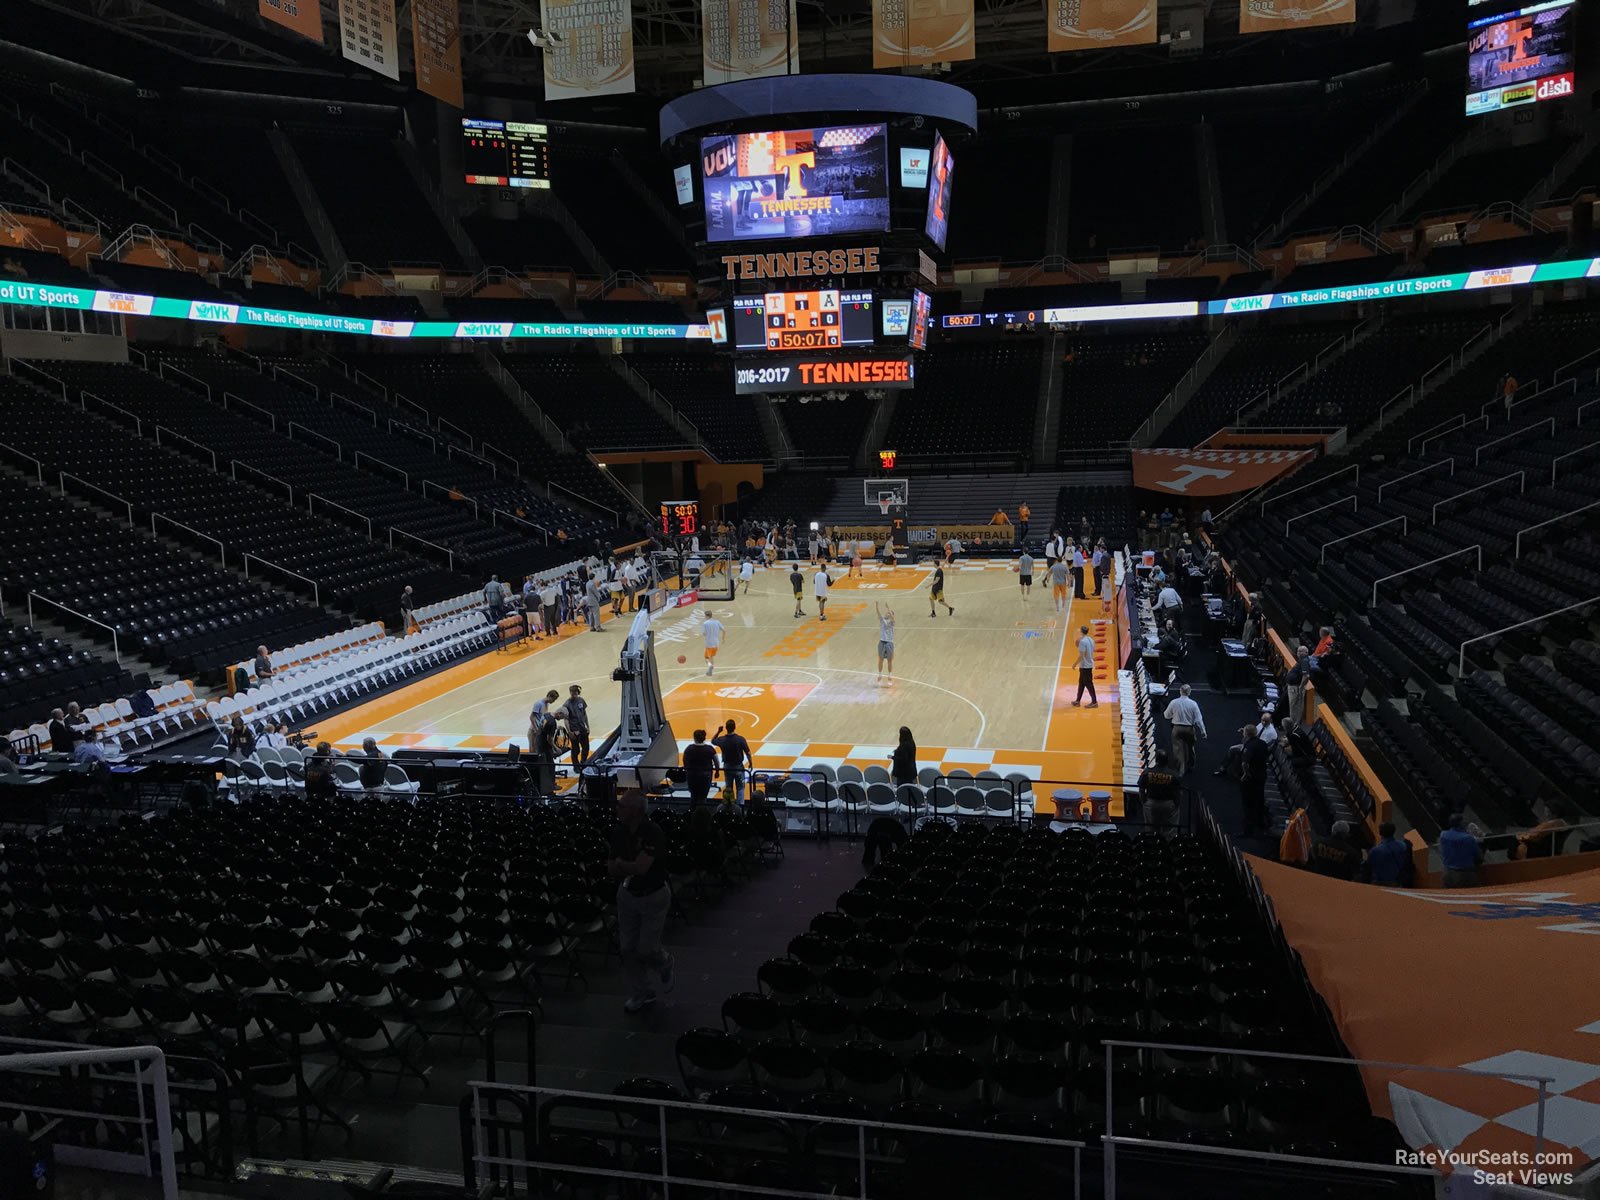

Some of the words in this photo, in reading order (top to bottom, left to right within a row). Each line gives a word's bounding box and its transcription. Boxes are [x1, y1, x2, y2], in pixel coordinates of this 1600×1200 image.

[546, 1, 624, 18] TOURNAMENT
[1058, 0, 1079, 9] 1972
[1249, 2, 1274, 11] 2008
[1058, 9, 1079, 17] 1977
[550, 13, 624, 30] CHAMPIONS
[738, 17, 759, 25] 2001
[1058, 18, 1079, 26] 1982
[738, 26, 759, 34] 2002
[738, 34, 760, 42] 2003
[738, 42, 760, 51] 2004
[1509, 28, 1532, 60] T
[1538, 77, 1571, 98] dish
[326, 105, 342, 115] 325
[1124, 101, 1140, 110] 330
[776, 151, 816, 197] T
[760, 197, 832, 212] TENNESSEE
[721, 246, 880, 280] TENNESSEE
[1, 286, 14, 298] of
[18, 287, 34, 300] UT
[39, 289, 79, 304] Sports
[1281, 293, 1298, 304] The
[1301, 290, 1329, 303] Radio
[1331, 286, 1380, 301] Flagships
[1382, 284, 1395, 295] of
[1397, 281, 1412, 293] UT
[1415, 278, 1452, 294] Sports
[769, 296, 780, 308] T
[824, 294, 834, 307] A
[247, 309, 262, 321] The
[264, 312, 286, 324] Radio
[288, 314, 322, 329] Flagships
[325, 318, 332, 328] of
[333, 319, 342, 329] UT
[344, 320, 365, 332] Sports
[773, 317, 779, 326] 0
[811, 318, 817, 326] 4
[826, 314, 833, 324] 0
[949, 316, 975, 326] 50:07
[1028, 311, 1035, 322] 0
[1050, 312, 1059, 321] A
[523, 325, 541, 335] The
[543, 325, 571, 335] Radio
[573, 326, 619, 338] Flagships
[621, 326, 631, 335] of
[632, 326, 645, 335] UT
[647, 326, 676, 338] Sports
[708, 314, 724, 340] T
[783, 333, 824, 346] 50:07
[737, 367, 790, 385] 2016-2017
[798, 361, 908, 385] TENNESSEE
[882, 458, 894, 468] 30
[1155, 464, 1235, 492] T
[674, 503, 699, 517] 50:07
[680, 516, 696, 535] 30
[893, 519, 904, 529] T
[941, 531, 1012, 541] BASKETBALL
